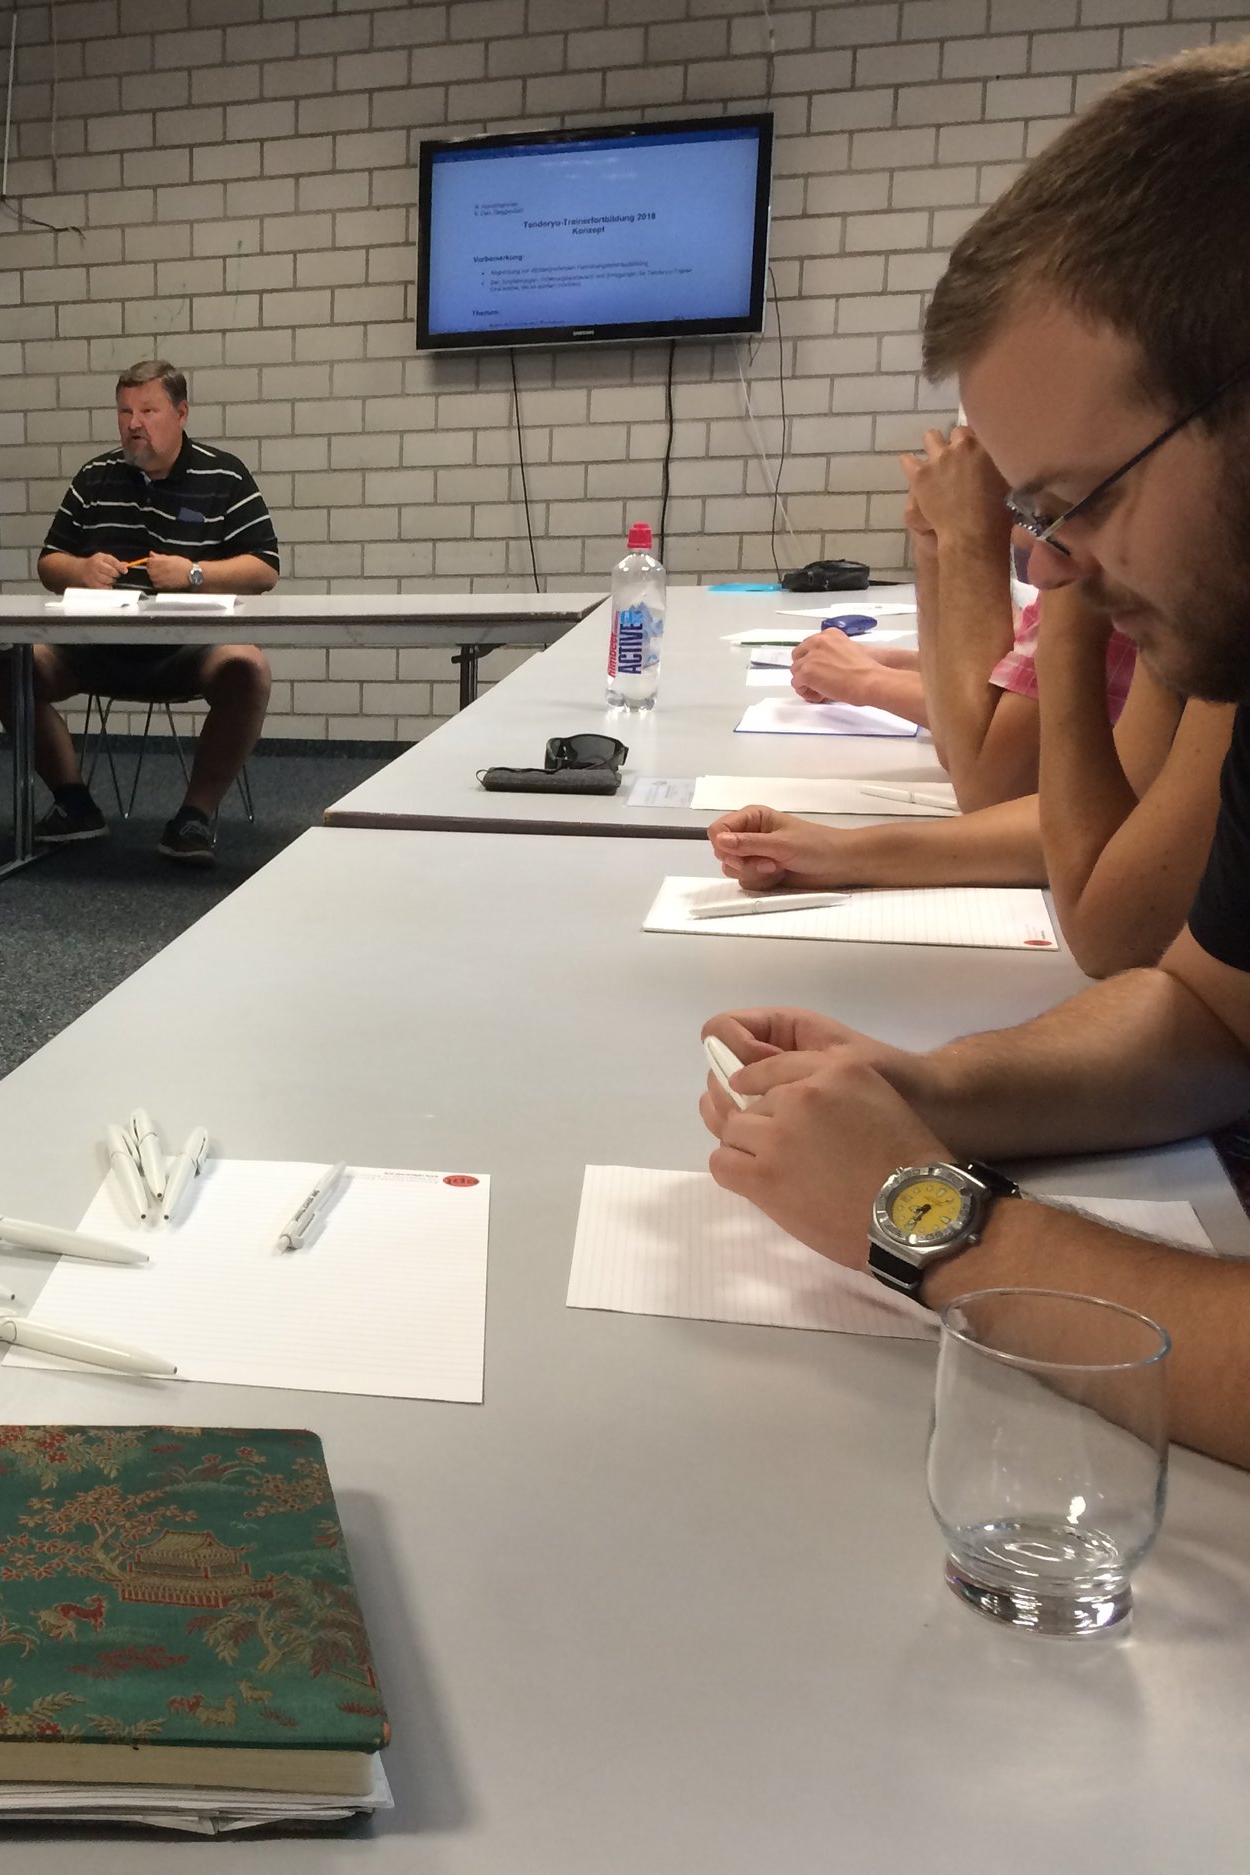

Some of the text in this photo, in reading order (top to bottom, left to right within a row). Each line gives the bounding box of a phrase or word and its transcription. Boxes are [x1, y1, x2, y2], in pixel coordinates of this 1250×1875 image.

[637, 212, 656, 221] 2018
[572, 225, 606, 235] Konzept
[617, 623, 643, 676] ACTIVE
